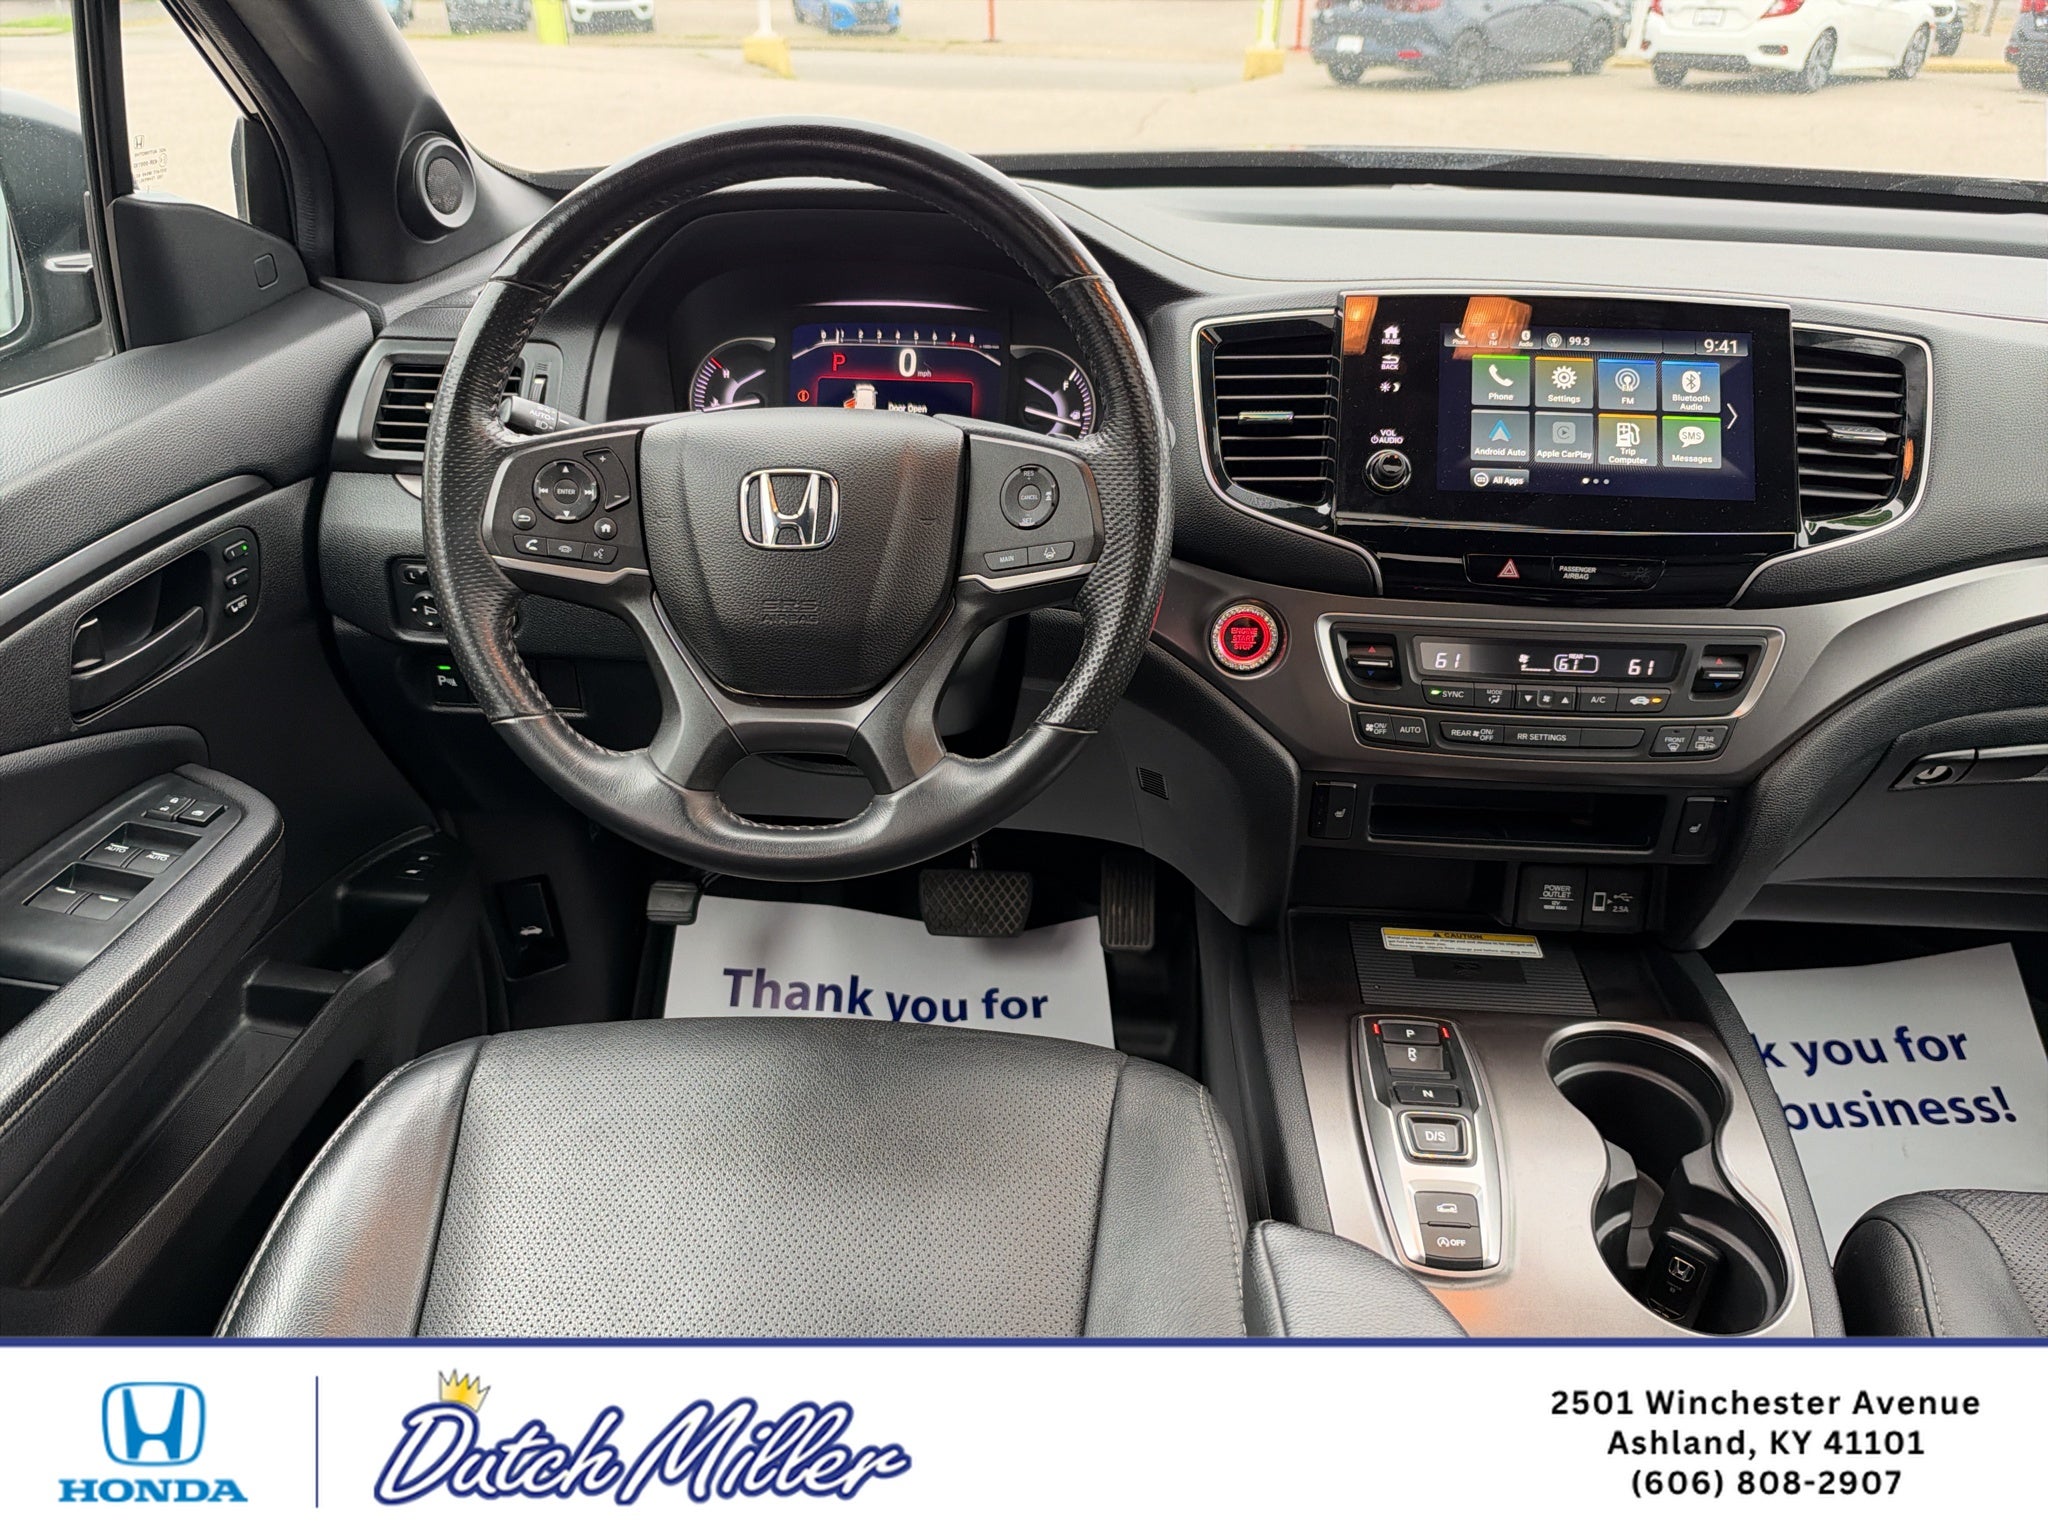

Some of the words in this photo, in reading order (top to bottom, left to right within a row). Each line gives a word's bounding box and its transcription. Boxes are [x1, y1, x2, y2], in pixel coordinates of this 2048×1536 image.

[1452, 338, 1469, 346] Phone
[1568, 336, 1591, 346] 99.3
[1703, 339, 1739, 354] 9:41
[832, 352, 847, 371] P
[898, 348, 917, 378] 0
[917, 370, 932, 378] mph
[1381, 363, 1399, 371] BACK
[1062, 380, 1070, 391] F
[1488, 392, 1514, 401] Phone
[1547, 394, 1581, 404] Settings
[1621, 397, 1635, 405] FM
[1672, 394, 1711, 403] Bluetooth
[888, 401, 906, 411] Door
[907, 402, 928, 413] Open
[1680, 403, 1703, 411] Audio
[529, 409, 551, 421] AUTO
[1379, 436, 1404, 444] AUDIO
[1681, 431, 1702, 440] SMS
[1474, 447, 1506, 456] Android
[1507, 448, 1527, 457] Auto
[1536, 451, 1560, 460] Apple
[1561, 450, 1592, 460] CarPlay
[1620, 447, 1636, 457] Trip
[1608, 456, 1648, 466] Computer
[1671, 455, 1713, 464] Messages
[1492, 476, 1503, 484] All
[1504, 476, 1525, 486] Apps
[1559, 565, 1597, 574] PASSENGER
[1562, 572, 1589, 580] AIRBAG
[1230, 627, 1259, 635] ENGINE
[1434, 652, 1462, 669] 61
[1627, 658, 1655, 676] 61
[1441, 690, 1465, 698] SYNC
[1590, 695, 1607, 704] A/C
[1400, 726, 1421, 734] AUTO
[1451, 729, 1472, 737] REAR
[1529, 733, 1567, 742] SETTINGS
[1664, 736, 1685, 744] FRONT
[104, 845, 127, 854] AUTO
[145, 854, 168, 862] AUTO
[1543, 884, 1571, 892] POWER
[1542, 890, 1571, 898] OUTLET
[1444, 932, 1483, 940] CAUTION
[722, 967, 874, 1017] Thank
[885, 990, 968, 1023] you
[981, 987, 1049, 1020] for
[1405, 1029, 1416, 1038] P
[1407, 1047, 1417, 1058] R
[1789, 1036, 1889, 1077] you
[1893, 1025, 1967, 1062] for
[1422, 1090, 1434, 1098] N
[1424, 1130, 1446, 1142] D/S
[1450, 1239, 1466, 1247] OFF
